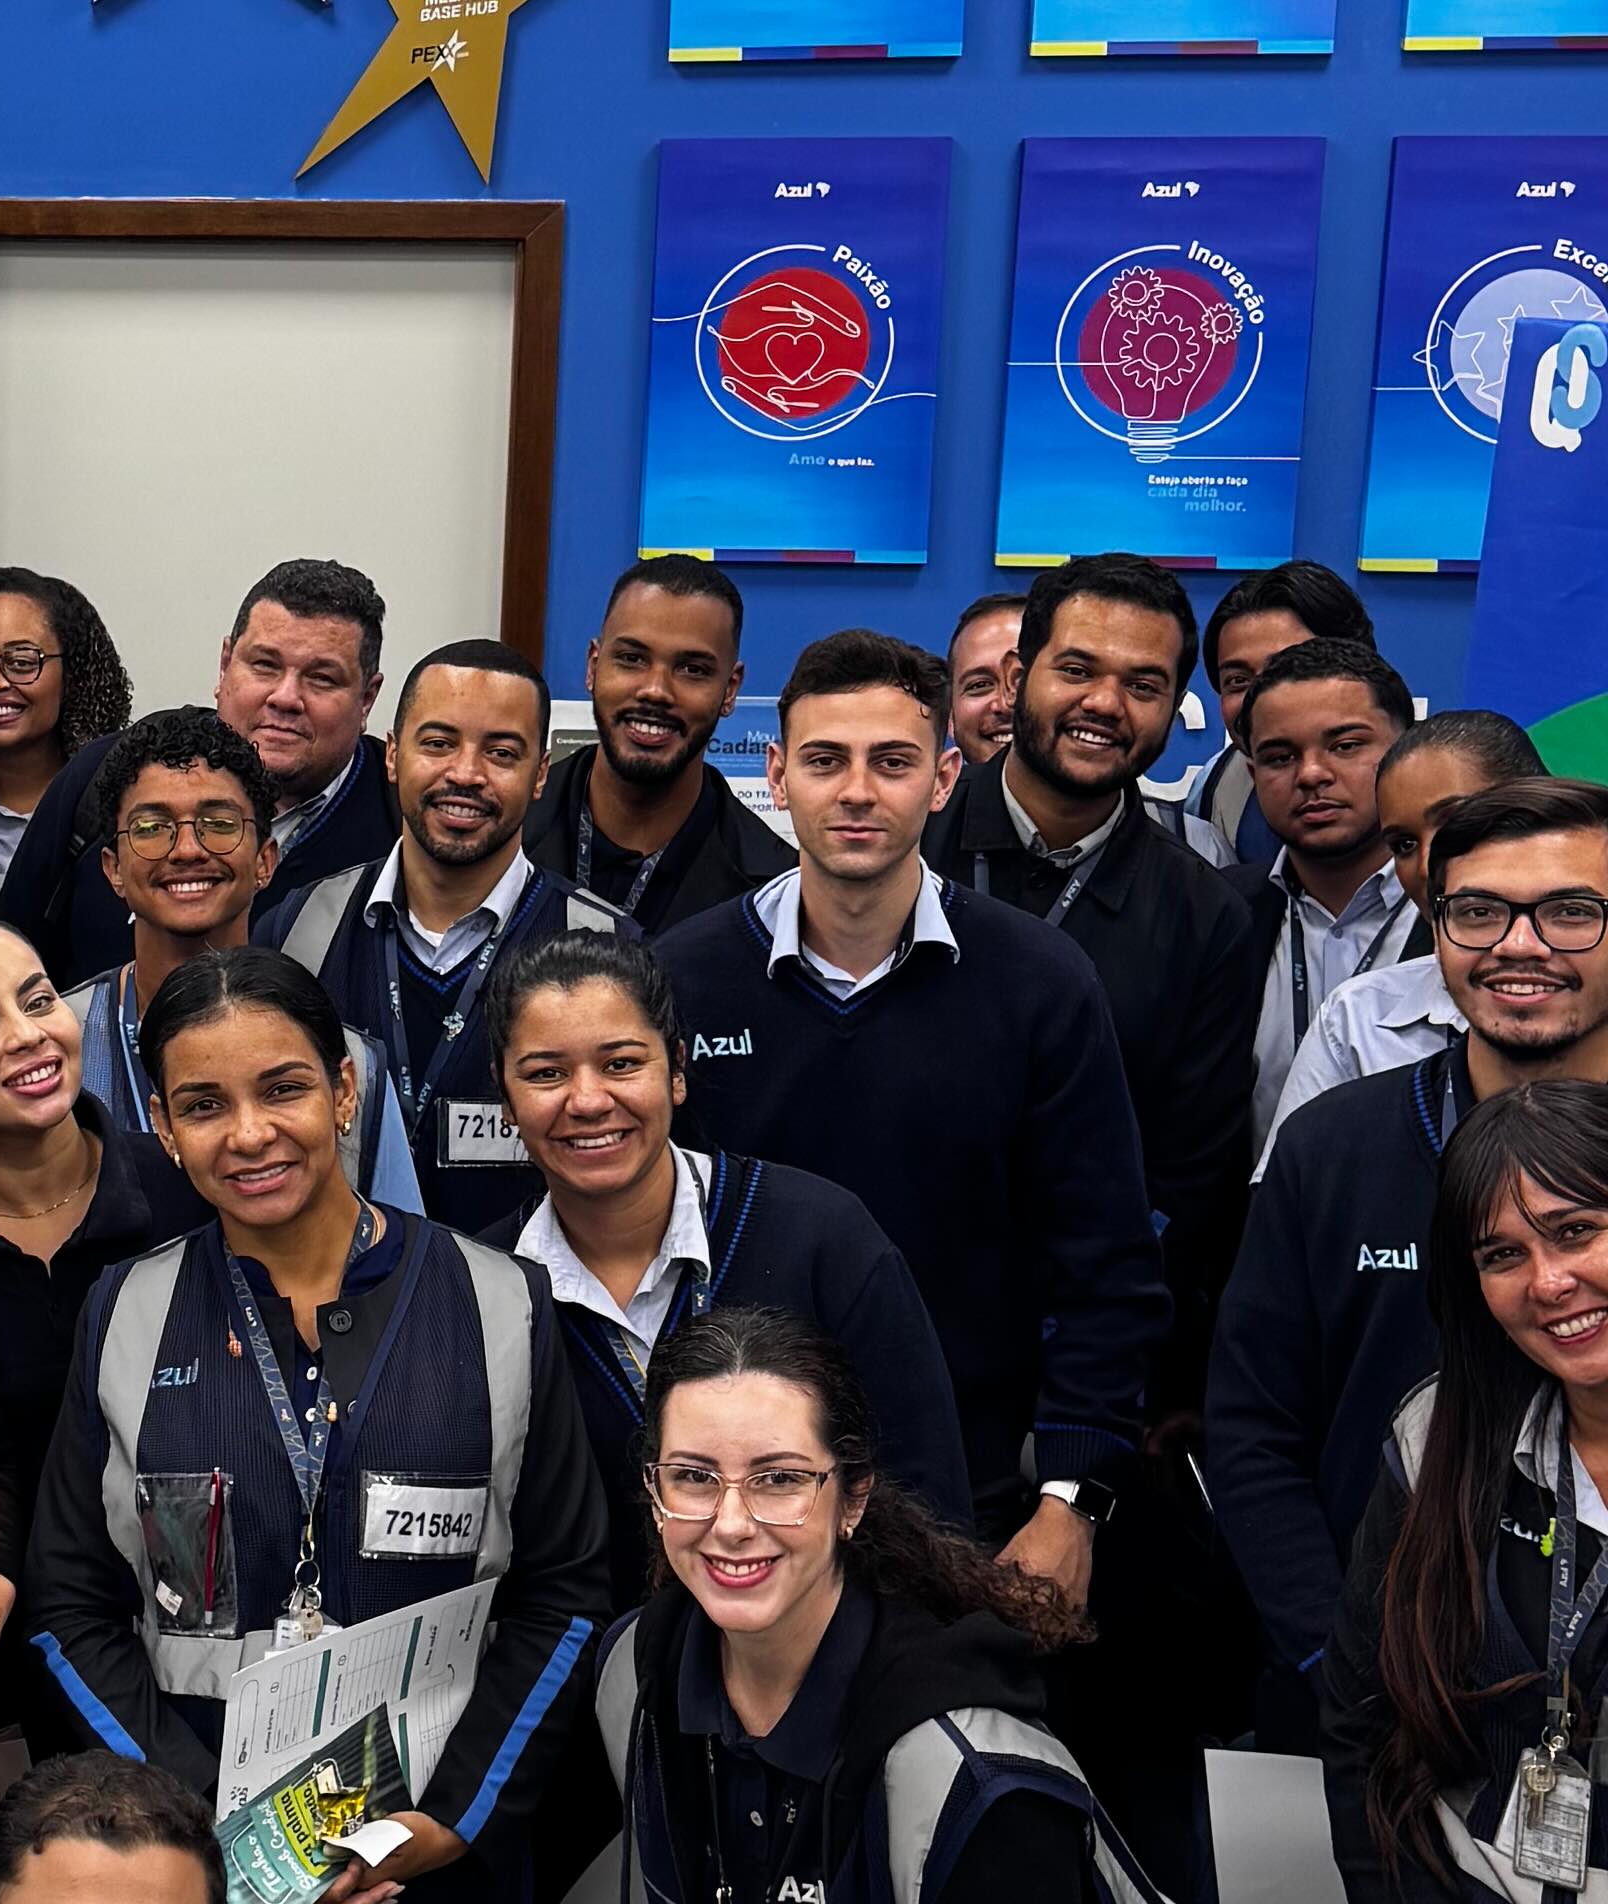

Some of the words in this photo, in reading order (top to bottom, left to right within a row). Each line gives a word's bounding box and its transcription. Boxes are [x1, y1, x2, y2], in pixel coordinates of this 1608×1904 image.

[420, 4, 461, 22] BASE
[465, 0, 499, 17] HUB
[774, 182, 812, 198] Azul
[1141, 181, 1181, 198] Azul
[1515, 181, 1556, 198] Azul
[831, 244, 891, 311] Paixão
[1187, 239, 1264, 326] Inovação
[788, 452, 825, 465] Ame
[1147, 486, 1188, 497] cada
[1192, 484, 1218, 498] dia
[1184, 499, 1247, 512] melhor.
[707, 738, 771, 755] Cadas
[691, 1028, 753, 1061] Azul
[457, 1114, 520, 1139] 7218
[1357, 1242, 1419, 1271] Azul
[151, 1357, 199, 1389] zul
[385, 1509, 473, 1538] 7215842
[280, 1791, 309, 1845] palma
